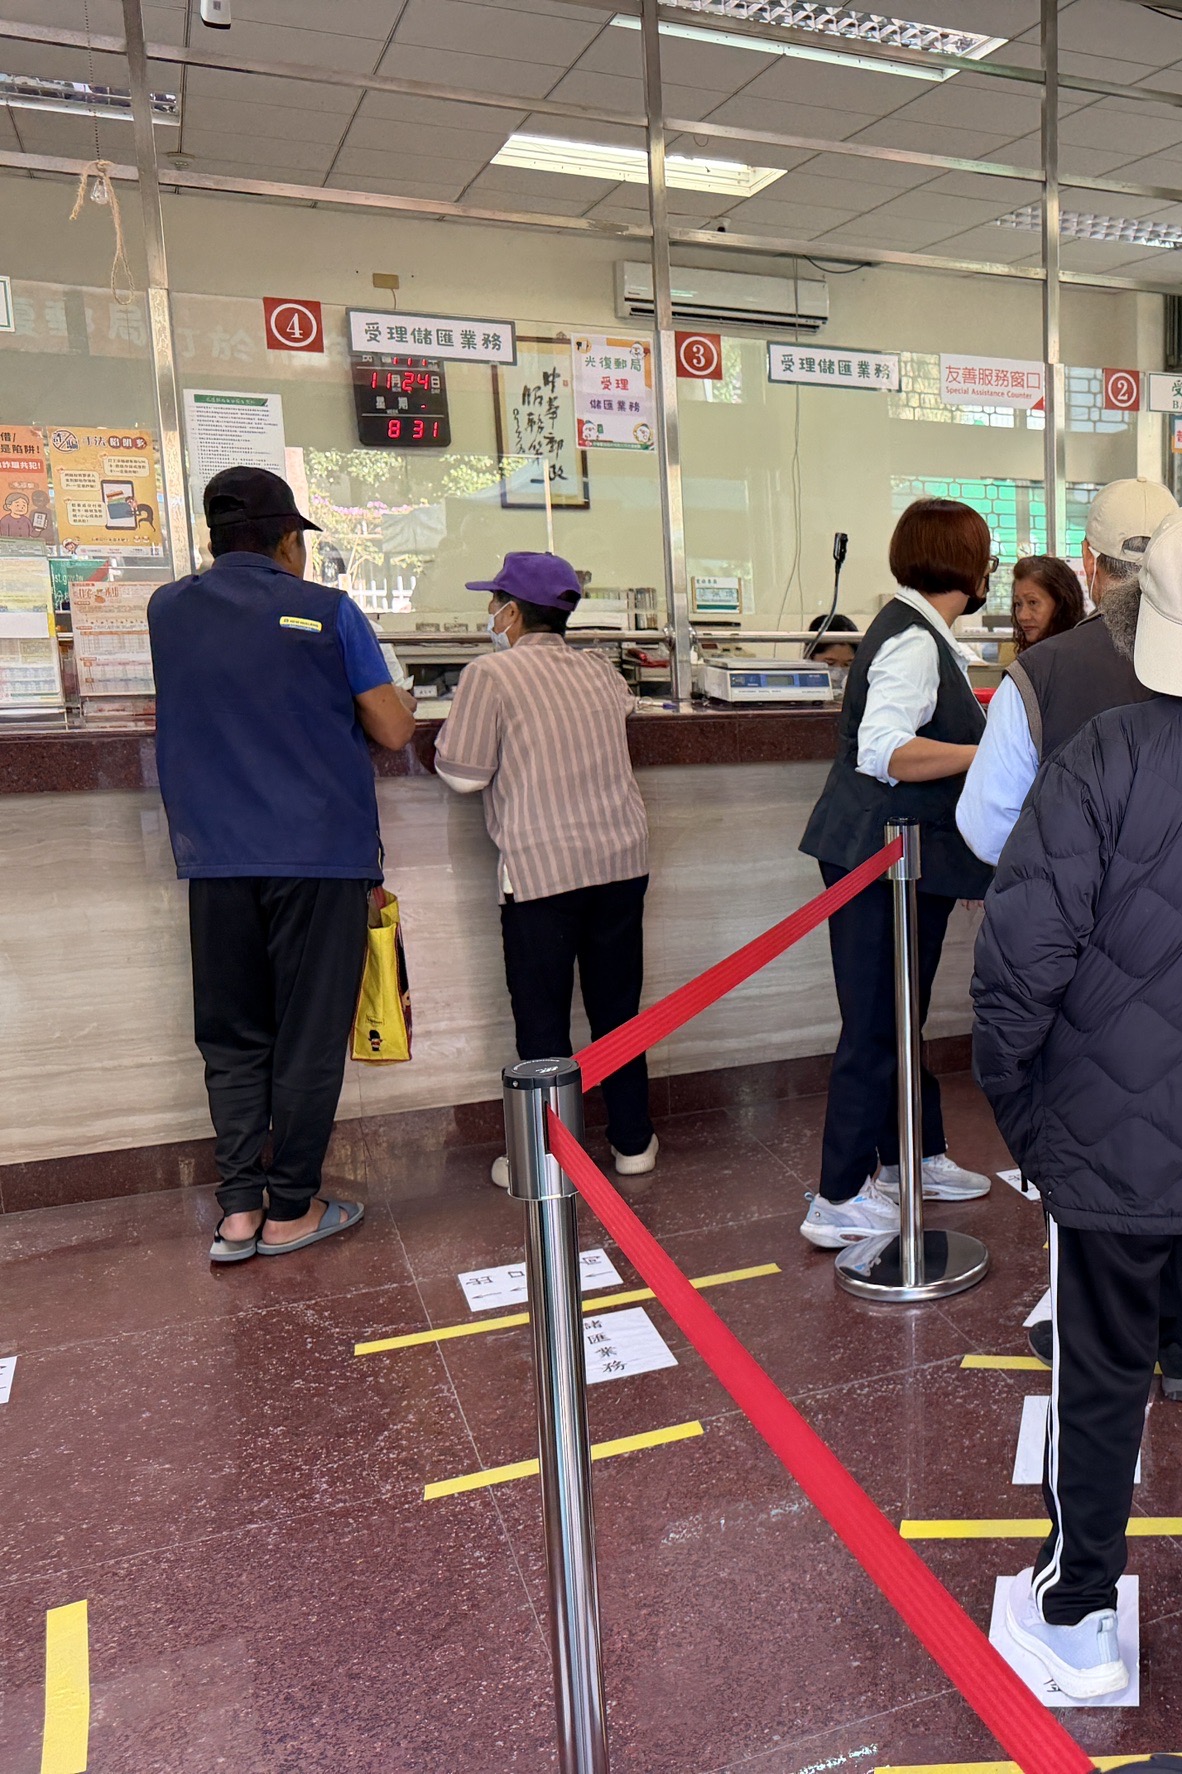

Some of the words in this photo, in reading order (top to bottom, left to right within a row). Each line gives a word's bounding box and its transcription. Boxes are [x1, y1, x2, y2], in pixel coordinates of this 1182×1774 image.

[286, 312, 304, 338] 4
[364, 322, 502, 350] 受理儲匯業務
[585, 355, 641, 372] 光復郵局
[692, 344, 705, 367] 3
[781, 353, 891, 380] 受理儲匯業務
[601, 376, 629, 391] 受理
[945, 365, 1041, 389] 友善服務窗口
[945, 386, 969, 396] Special
[971, 388, 1006, 398] Assistance
[1007, 391, 1032, 399] Counter
[1117, 380, 1128, 400] 2
[590, 399, 640, 412] 儲匯業務
[0, 461, 40, 470] 詐騙共犯!
